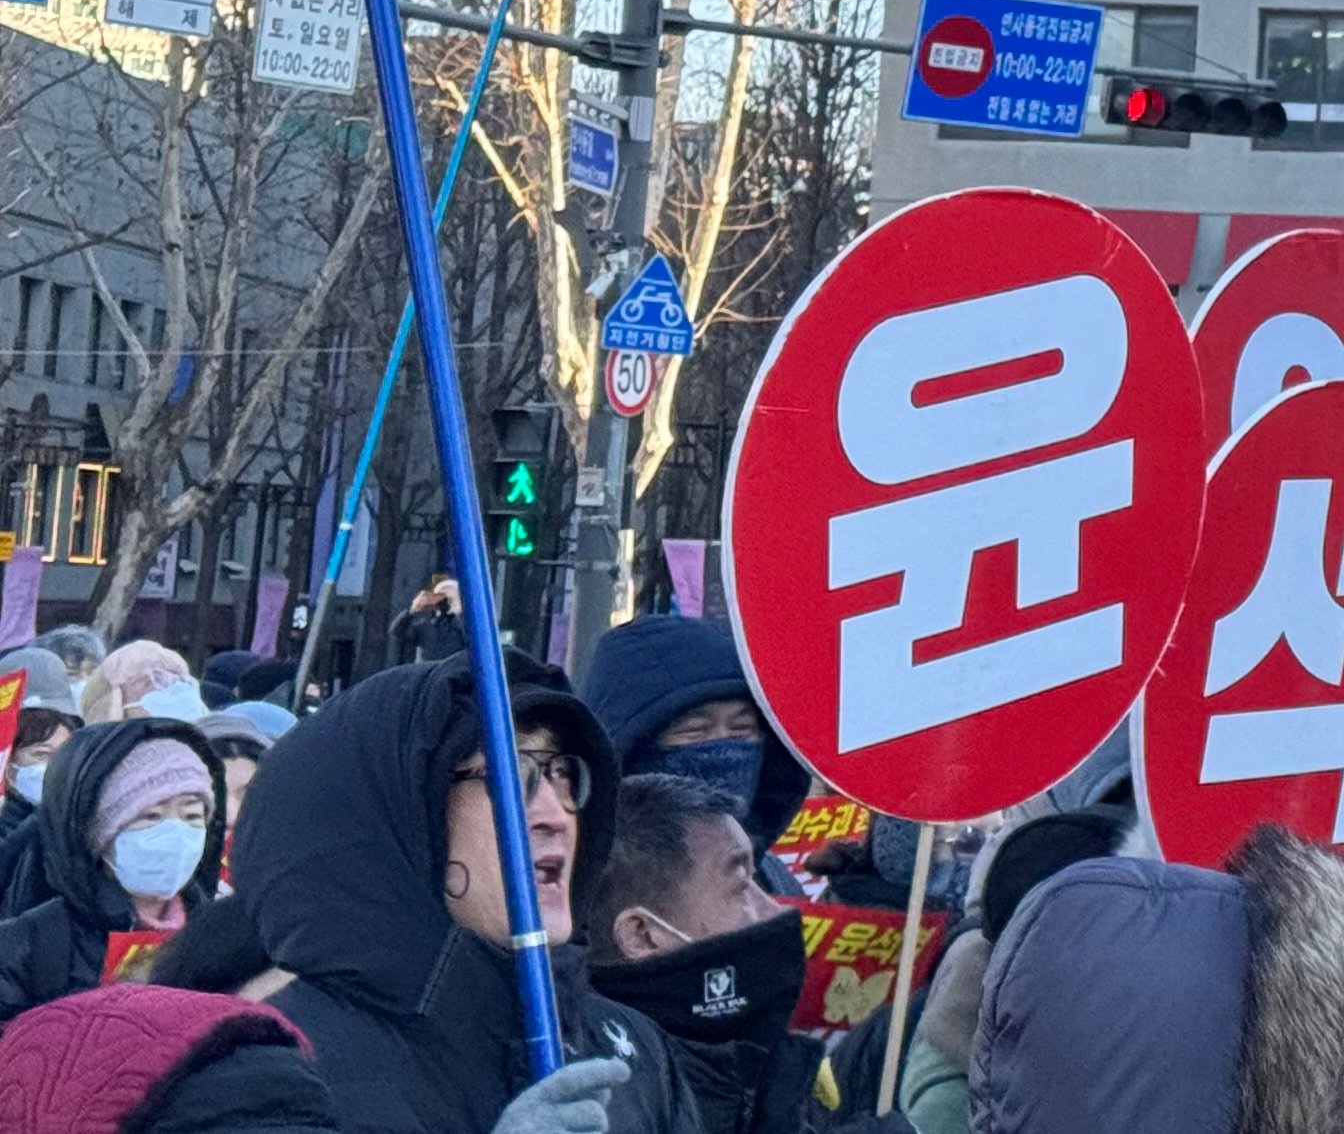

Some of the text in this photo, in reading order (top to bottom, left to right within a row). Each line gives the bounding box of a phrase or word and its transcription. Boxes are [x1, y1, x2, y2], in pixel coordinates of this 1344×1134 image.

[300, 22, 349, 49] 일요일
[608, 329, 686, 351] 자전거횡단
[617, 353, 646, 395] 50
[828, 274, 1134, 755] 윤
